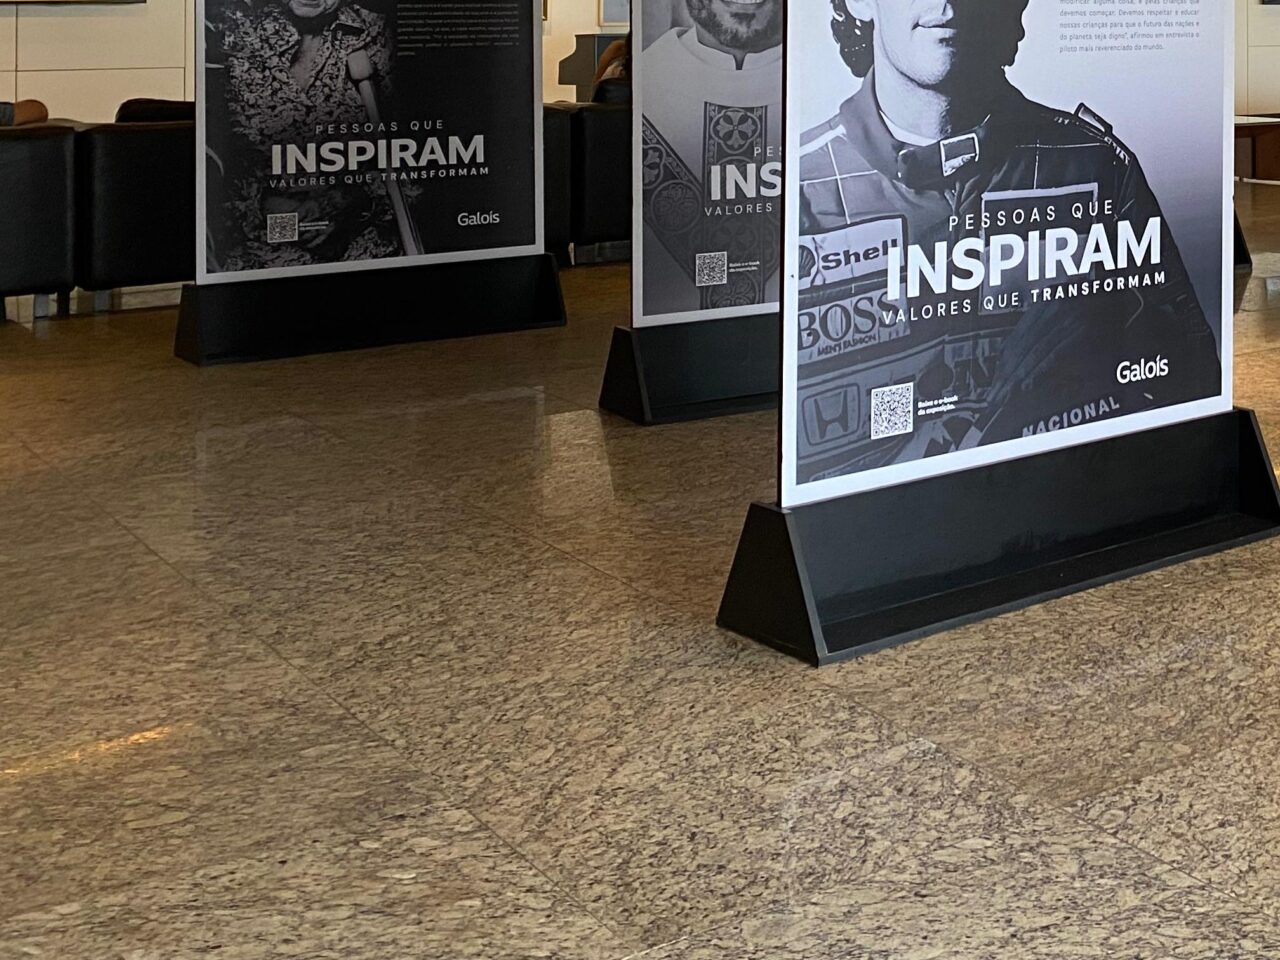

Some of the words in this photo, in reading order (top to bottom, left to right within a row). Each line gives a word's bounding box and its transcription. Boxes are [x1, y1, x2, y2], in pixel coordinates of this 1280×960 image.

[315, 122, 398, 134] PESSOAS
[410, 120, 444, 131] QUE
[271, 134, 485, 175] INSPIRAM
[754, 146, 782, 157] PE
[269, 175, 336, 188] VALORES
[344, 173, 373, 184] QUE
[381, 167, 489, 181] TRANSFORMAM
[710, 161, 782, 201] INS
[704, 202, 773, 217] VALORES
[949, 205, 1056, 231] PESSOAS
[1071, 200, 1113, 219] QUE
[887, 216, 1161, 301] INSPIRAM
[882, 299, 972, 325] VALORES
[983, 291, 1020, 311] QUE
[1031, 271, 1166, 303] TRANSFORMAM
[797, 290, 899, 350] BOSS
[1022, 396, 1120, 438] NACIONAL
